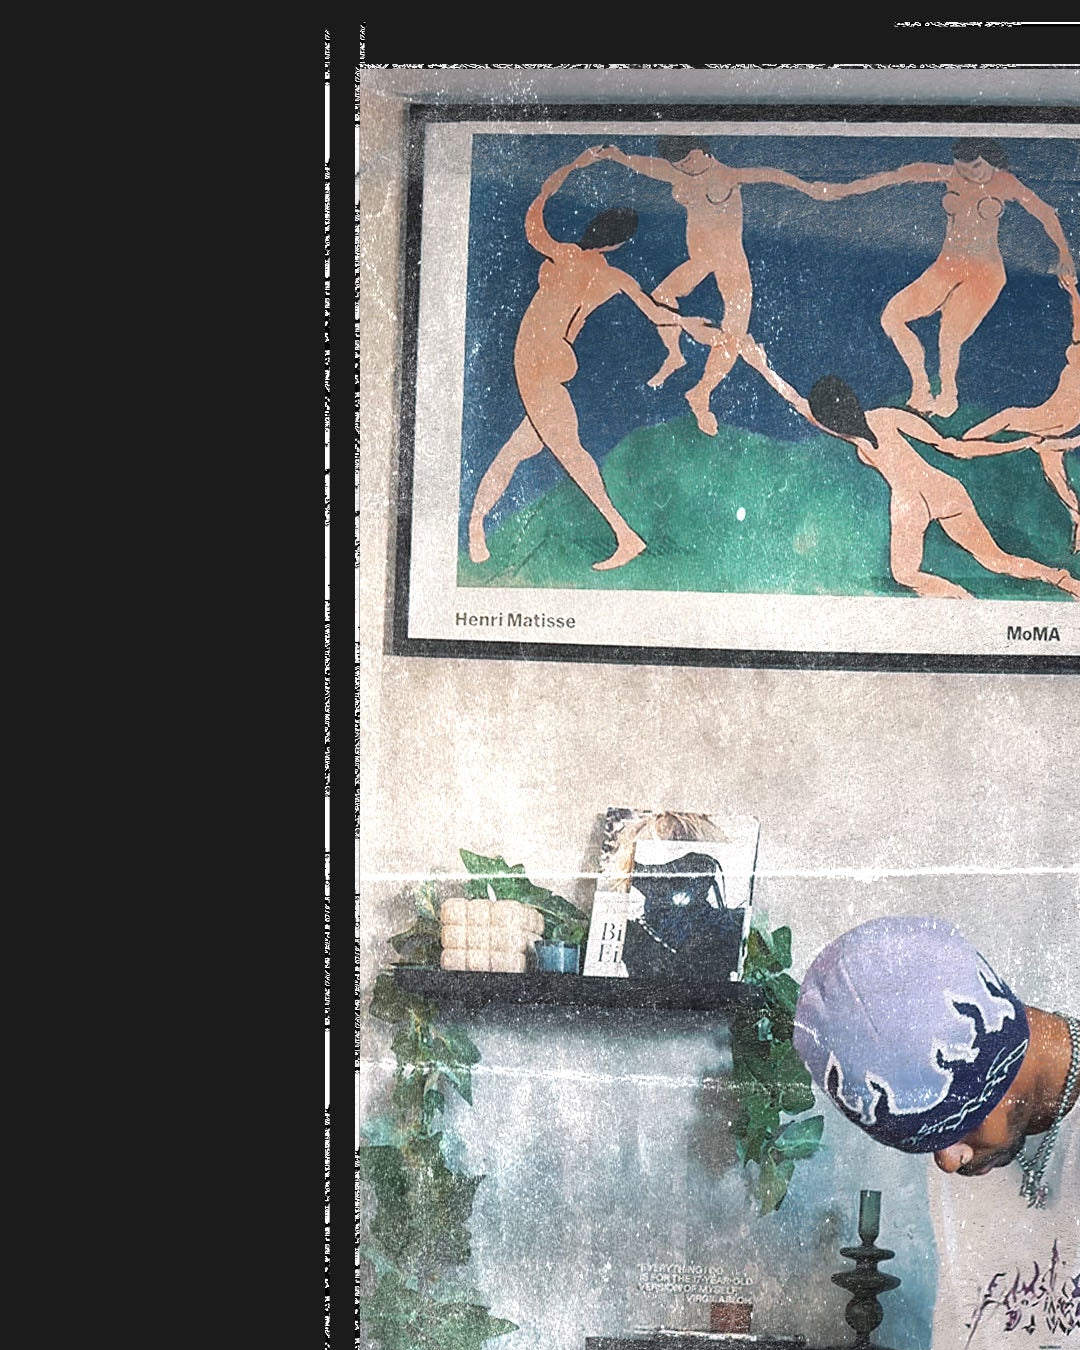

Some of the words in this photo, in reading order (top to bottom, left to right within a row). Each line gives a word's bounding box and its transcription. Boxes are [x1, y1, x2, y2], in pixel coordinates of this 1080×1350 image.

[455, 612, 503, 627] Henri
[507, 612, 576, 628] Matisse
[1006, 625, 1060, 641] MoMA
